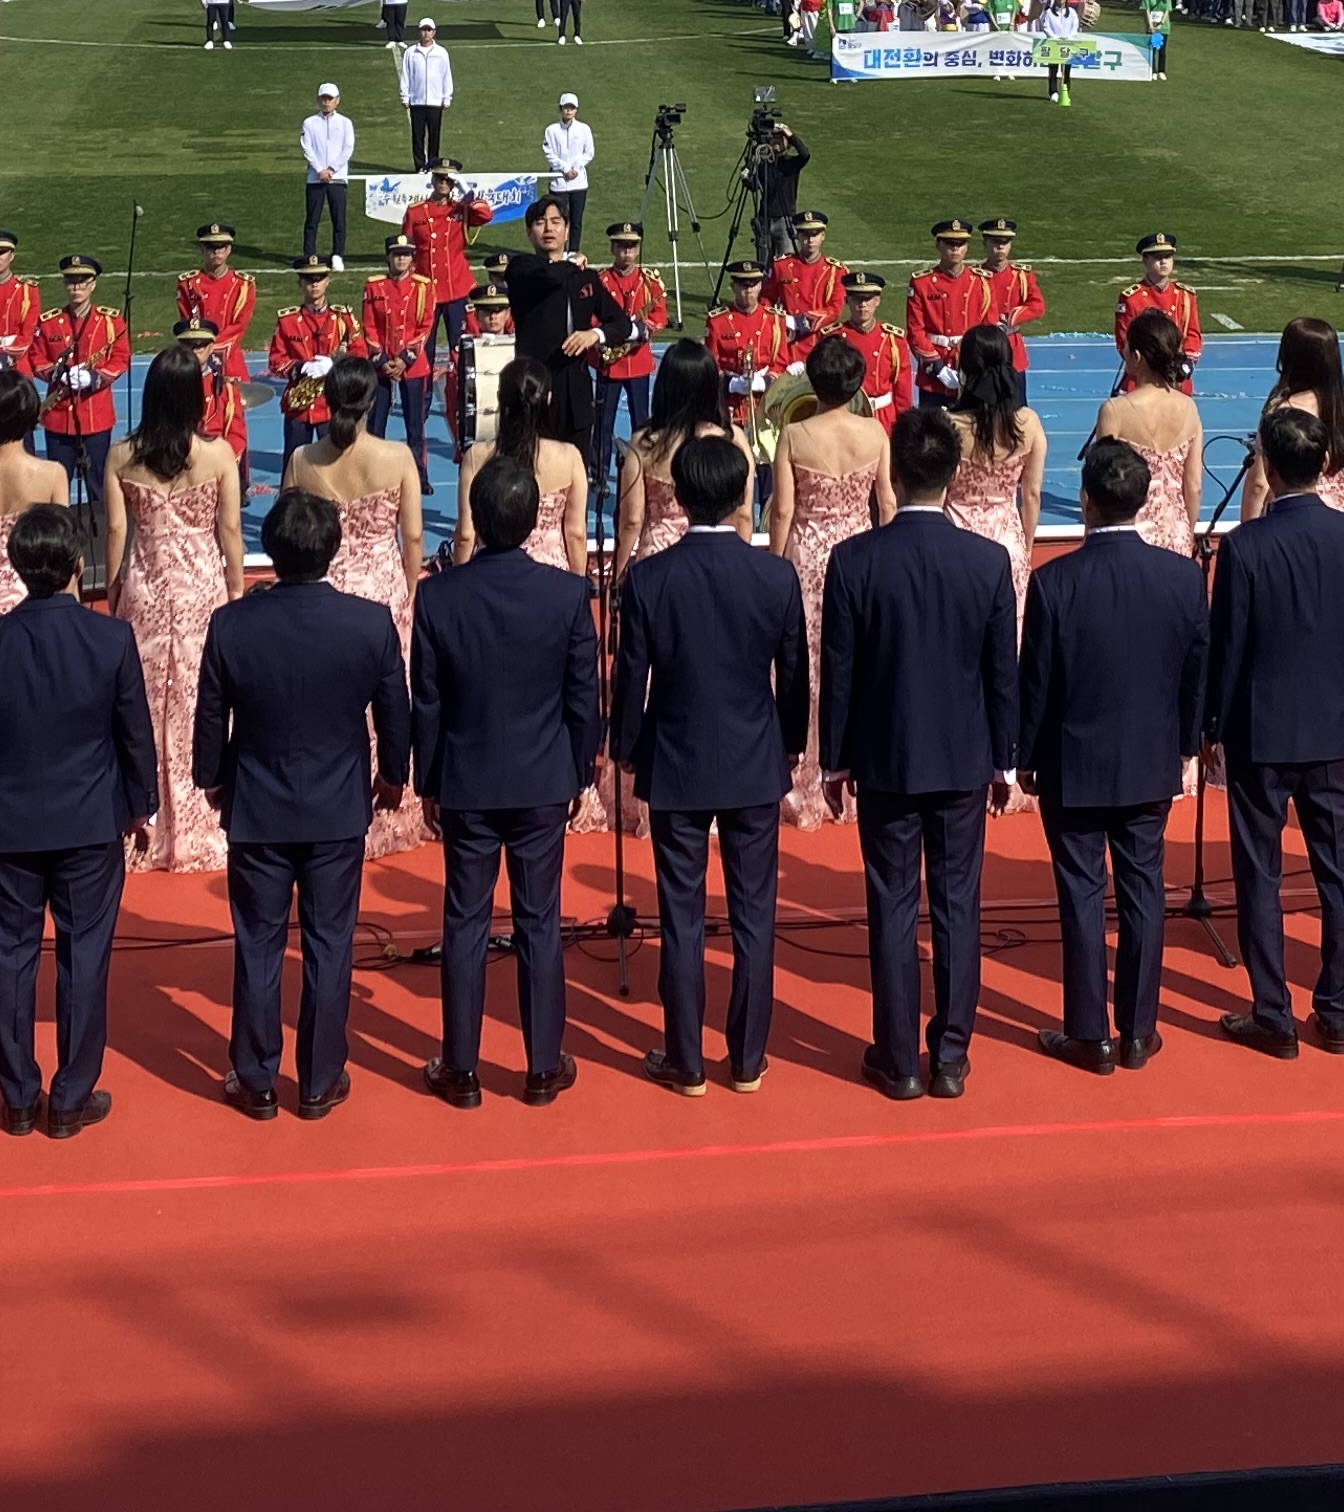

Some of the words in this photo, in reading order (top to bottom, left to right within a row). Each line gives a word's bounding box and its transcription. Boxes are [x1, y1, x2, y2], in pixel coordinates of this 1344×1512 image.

[863, 47, 939, 70] 대전환의
[944, 50, 983, 70] 중심,
[1039, 46, 1090, 59] 팔달구
